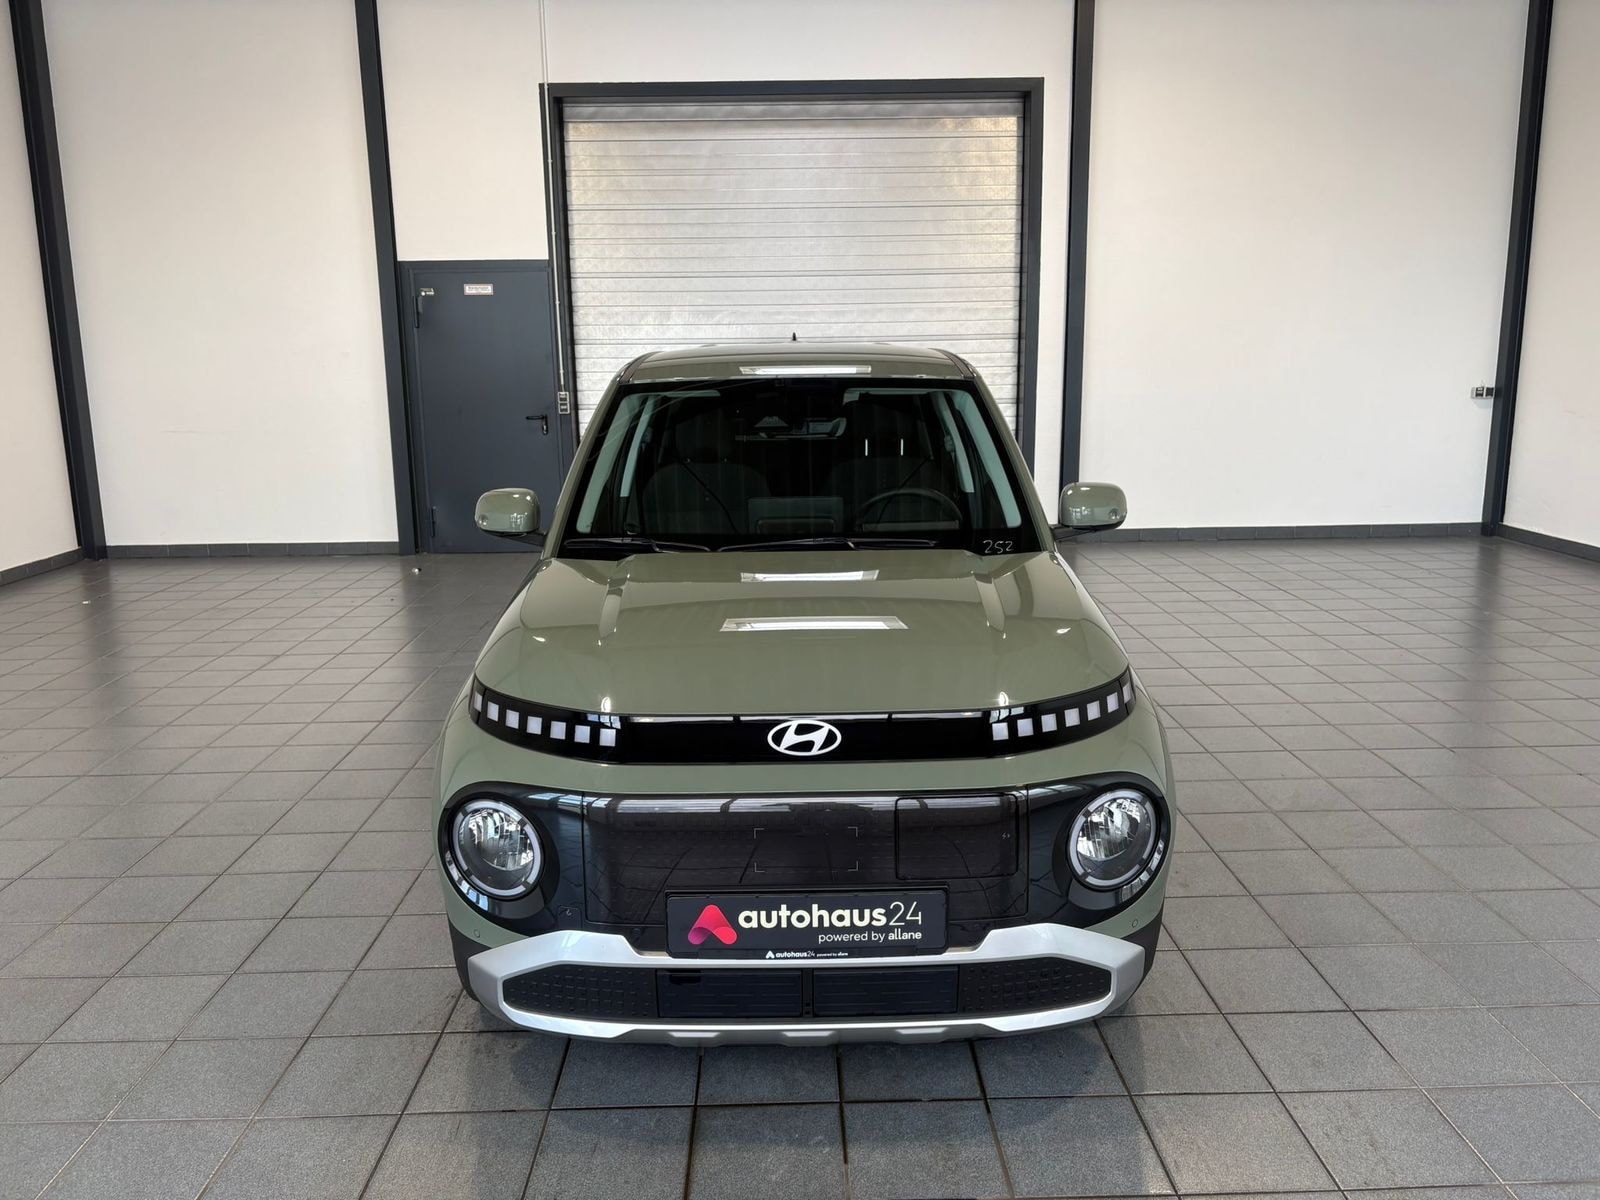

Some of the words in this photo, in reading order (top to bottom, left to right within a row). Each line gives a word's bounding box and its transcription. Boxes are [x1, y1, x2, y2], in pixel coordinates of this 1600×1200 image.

[982, 539, 1014, 554] 252
[738, 901, 923, 929] autohaus24
[818, 931, 868, 945] powered
[871, 930, 886, 943] by
[888, 928, 922, 941] allane
[775, 950, 815, 958] autohaus24
